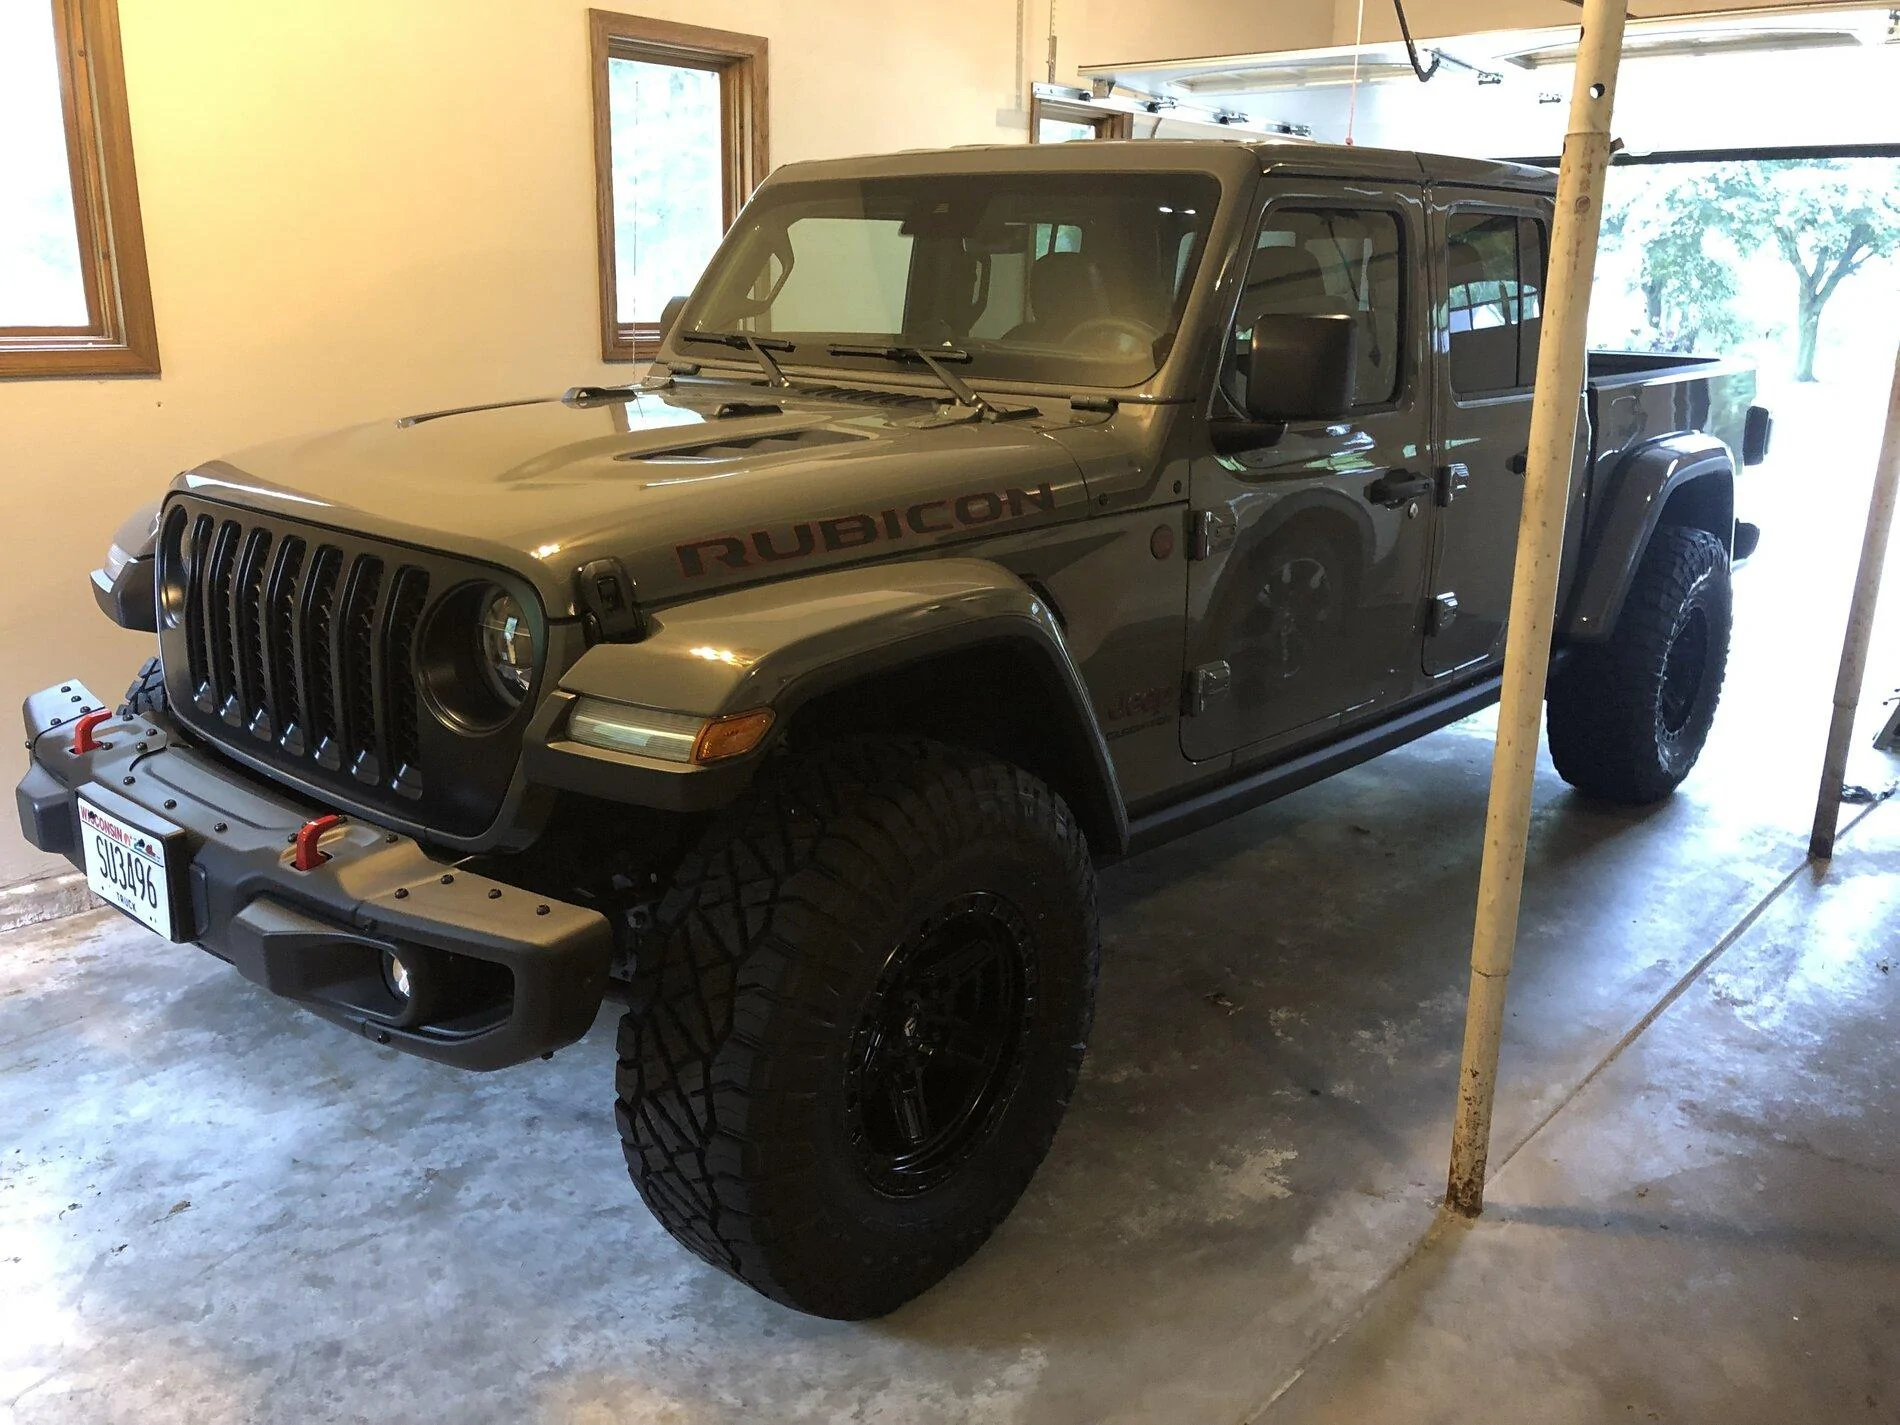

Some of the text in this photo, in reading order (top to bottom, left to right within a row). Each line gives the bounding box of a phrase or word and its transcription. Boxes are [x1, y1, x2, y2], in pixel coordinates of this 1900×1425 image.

[675, 483, 1056, 578] RUBICON
[96, 835, 158, 909] SU3496
[116, 891, 136, 912] TRUCK
